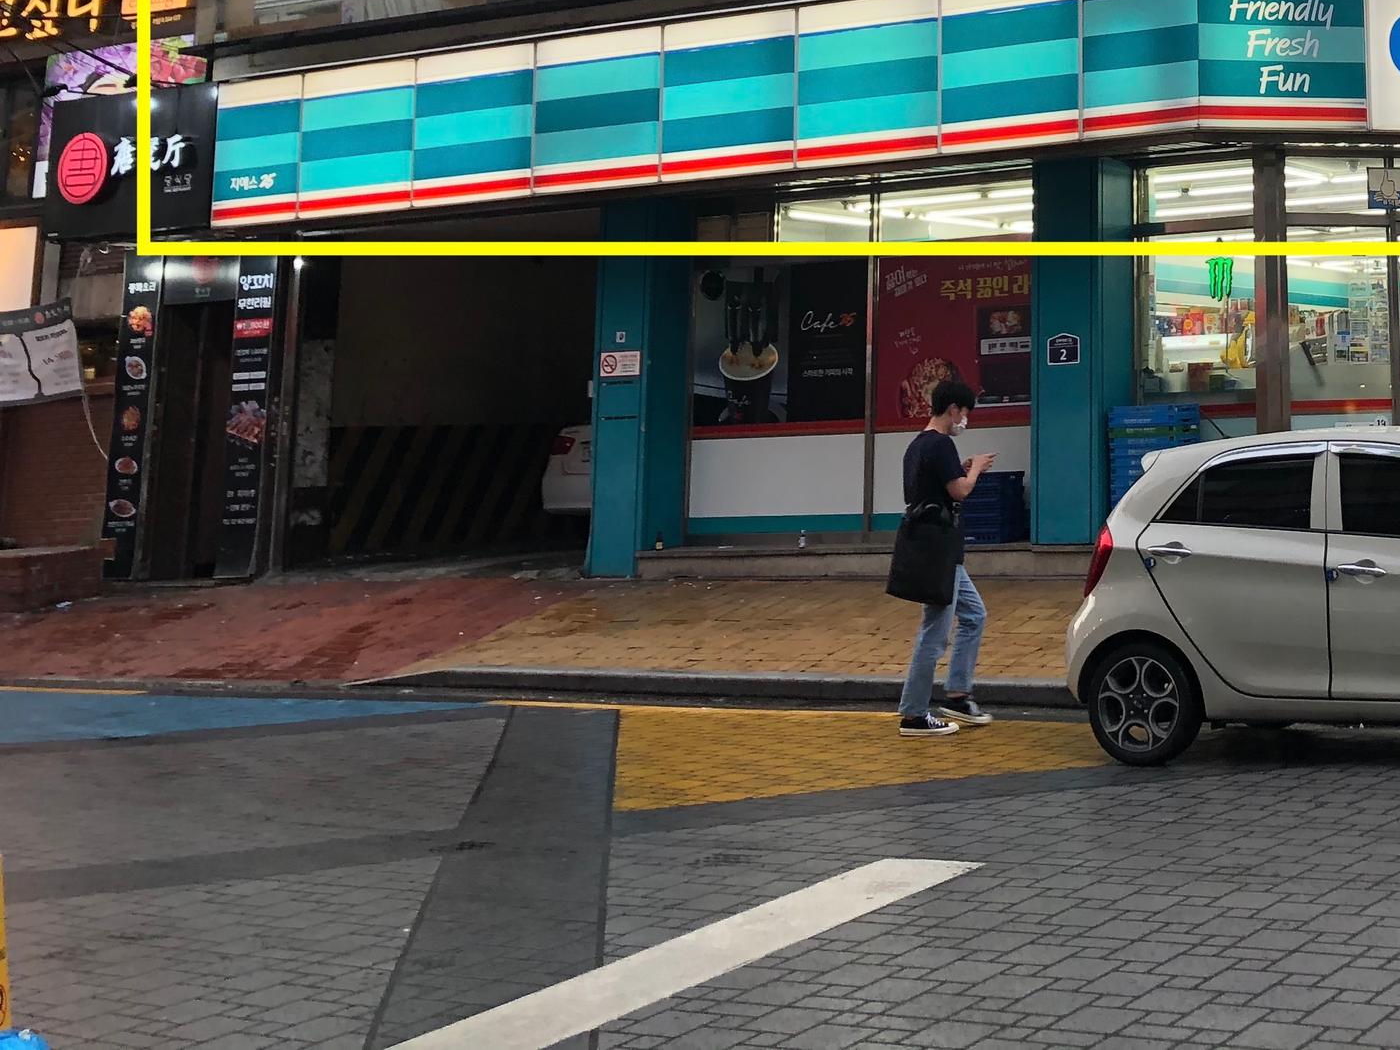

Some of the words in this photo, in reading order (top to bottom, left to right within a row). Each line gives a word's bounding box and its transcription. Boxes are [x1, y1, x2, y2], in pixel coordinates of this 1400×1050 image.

[1245, 28, 1320, 58] Fresh
[1259, 65, 1310, 94] Fun
[941, 278, 973, 300] 즉석
[1013, 274, 1030, 295] 라
[801, 311, 839, 332] Cafe
[1060, 349, 1067, 360] 2
